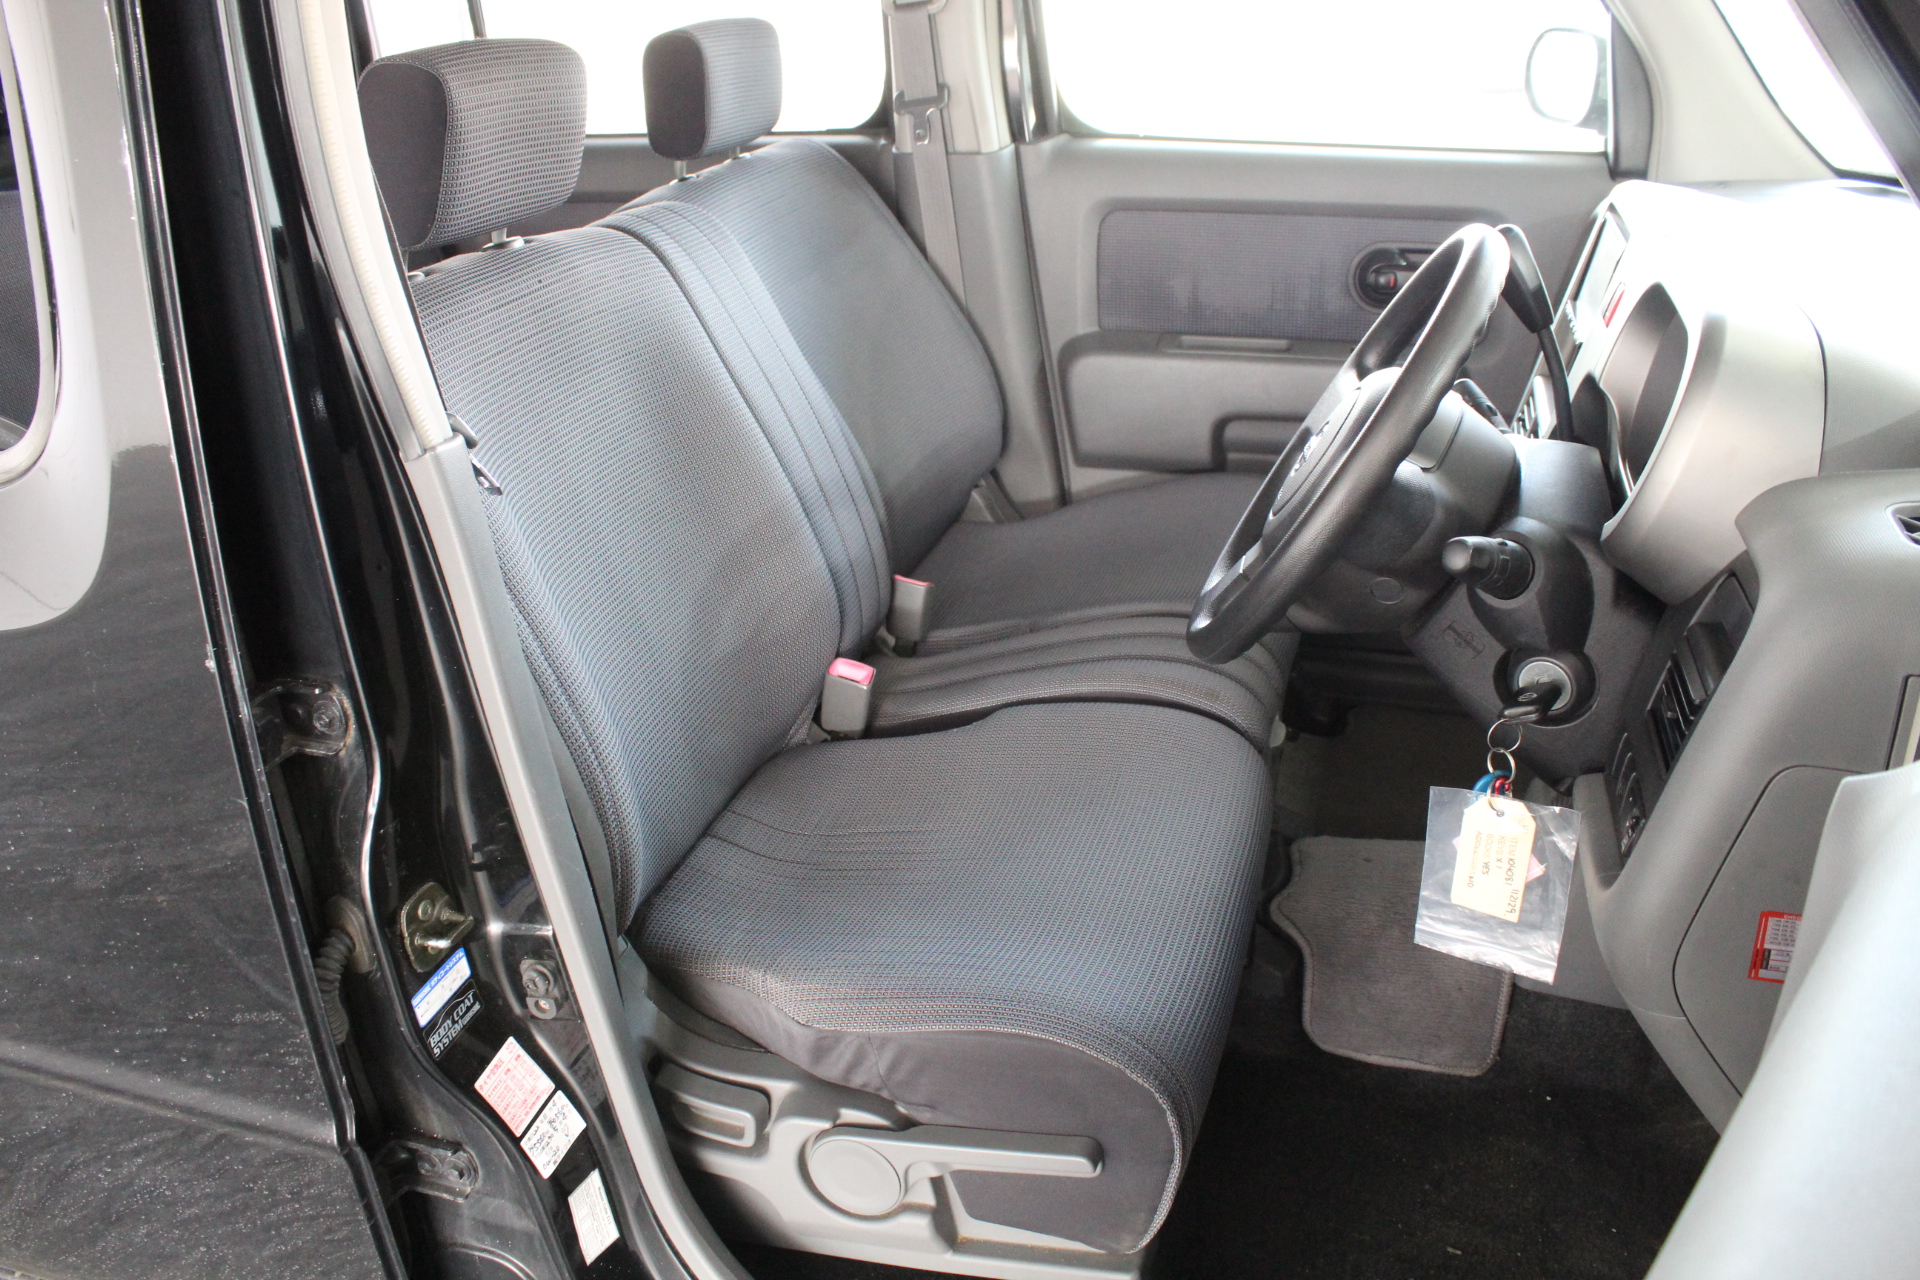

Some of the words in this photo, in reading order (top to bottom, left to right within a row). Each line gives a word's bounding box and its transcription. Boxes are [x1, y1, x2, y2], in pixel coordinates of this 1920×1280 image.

[1482, 833, 1494, 859] BOOKS
[1495, 835, 1506, 855] KEYS
[1508, 837, 1518, 857] ITEM
[1481, 861, 1491, 876] YES
[429, 1015, 453, 1048] BODY
[452, 991, 475, 1022] COAT
[433, 1019, 463, 1058] SYSTEM
[478, 1057, 505, 1092] タイヤ空気圧
